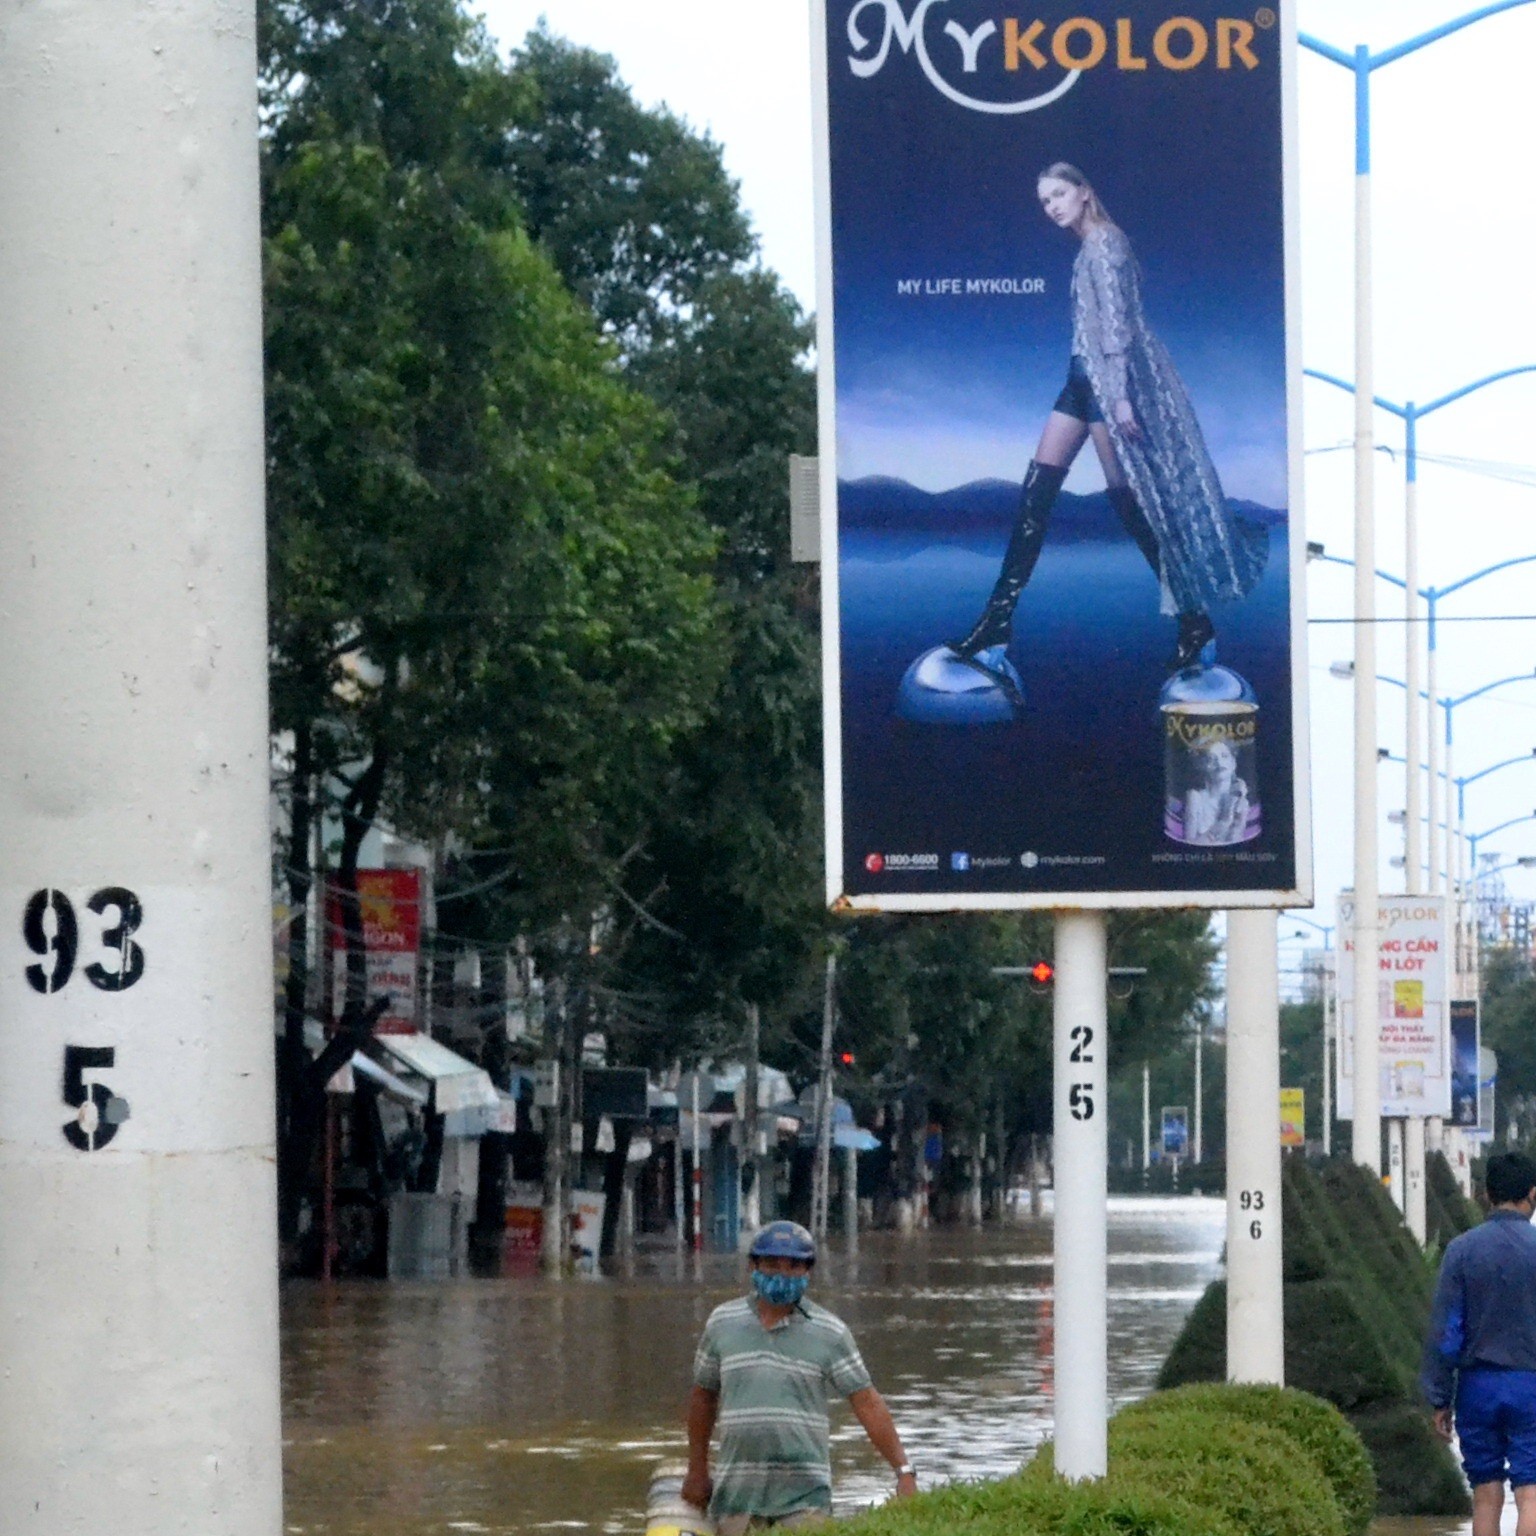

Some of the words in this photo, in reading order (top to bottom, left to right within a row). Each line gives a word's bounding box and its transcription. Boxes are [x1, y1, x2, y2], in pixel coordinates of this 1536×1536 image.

[898, 278, 921, 295] MY
[926, 278, 962, 295] LIFE
[966, 278, 1045, 295] MYKOLOR
[24, 886, 146, 994] 93
[1069, 1026, 1093, 1062] 2
[62, 1046, 122, 1152] 5
[1069, 1083, 1095, 1121] 5
[1240, 1190, 1265, 1211] 93
[1250, 1220, 1262, 1240] 6
